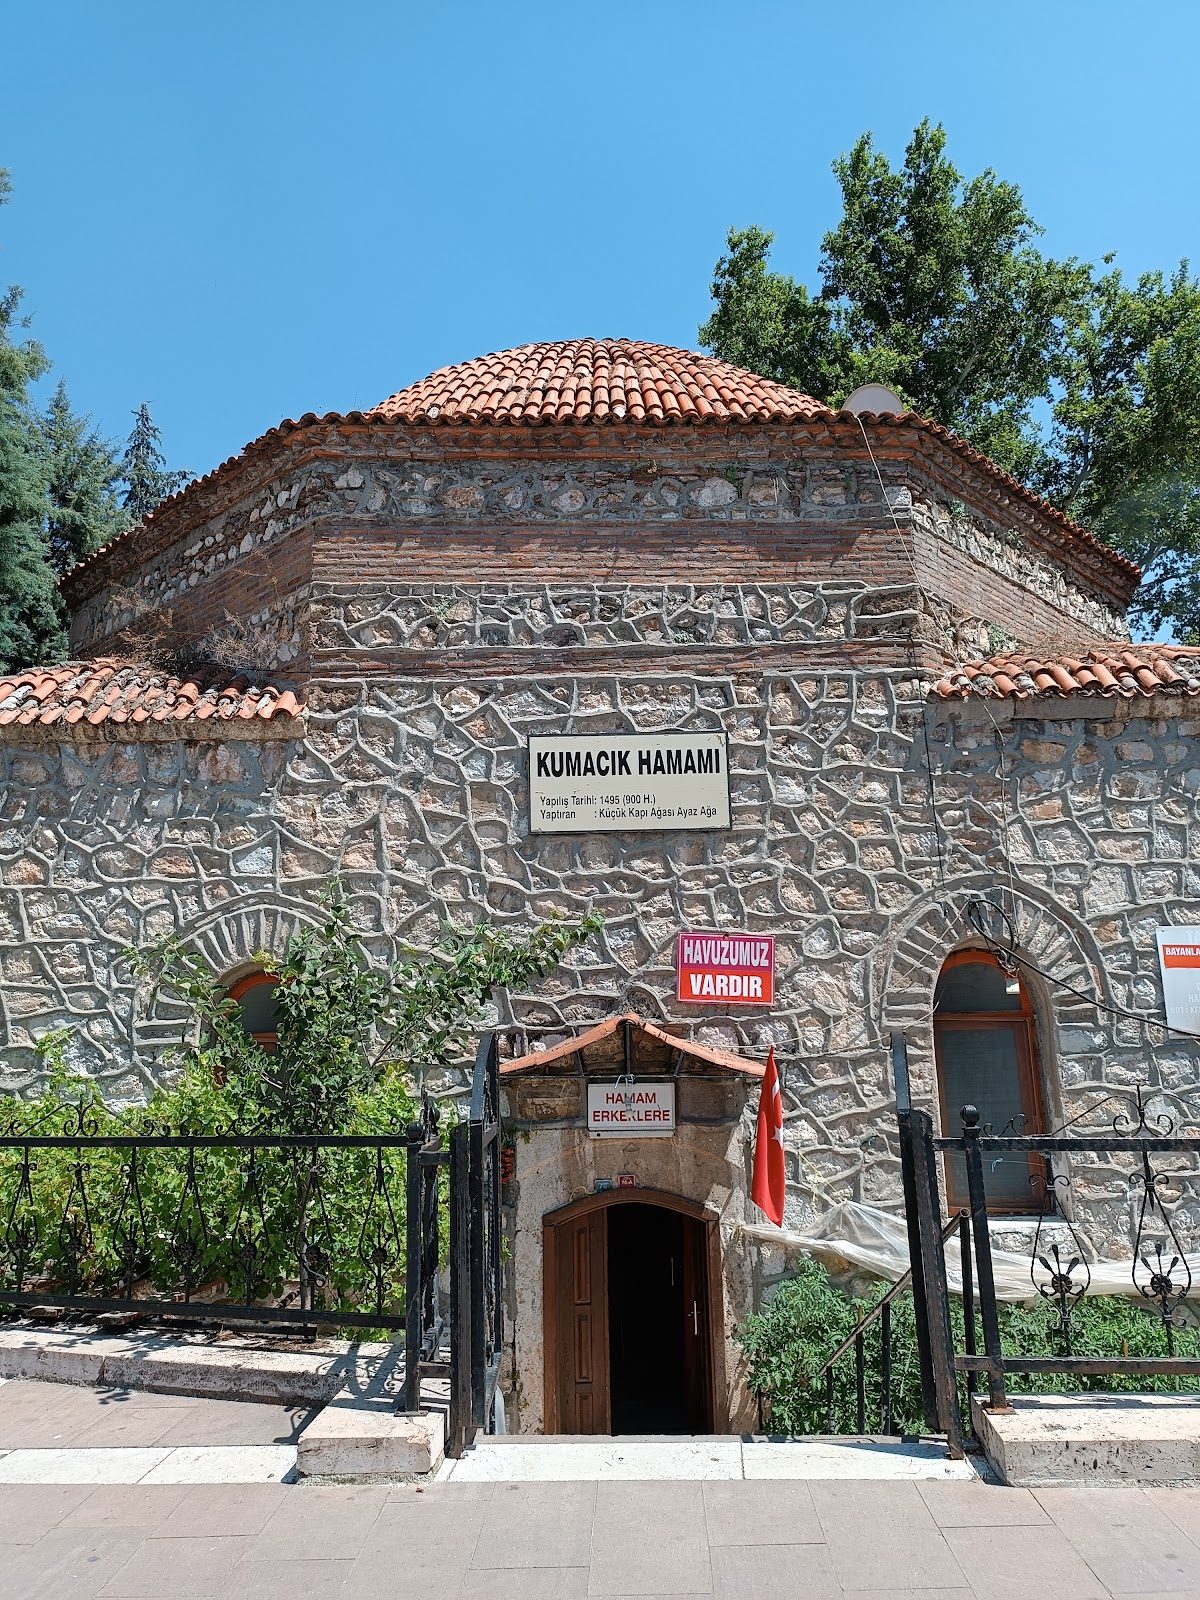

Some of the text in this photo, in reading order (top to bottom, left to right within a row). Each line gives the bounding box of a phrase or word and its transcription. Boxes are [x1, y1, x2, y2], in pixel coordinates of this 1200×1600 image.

[537, 748, 720, 777] KUMACIK HAMAMI
[540, 793, 656, 809] Yapılış Tarihi: 1495 (900 H.)
[540, 809, 576, 821] Yaptıran
[599, 807, 627, 820] Küçük
[628, 807, 648, 819] Kapı
[650, 807, 675, 819] Ağası
[677, 806, 698, 819] Ayaz
[700, 805, 717, 818] Ağa
[683, 939, 769, 966] HAVUZUMUZ
[689, 973, 763, 997] VARDIR
